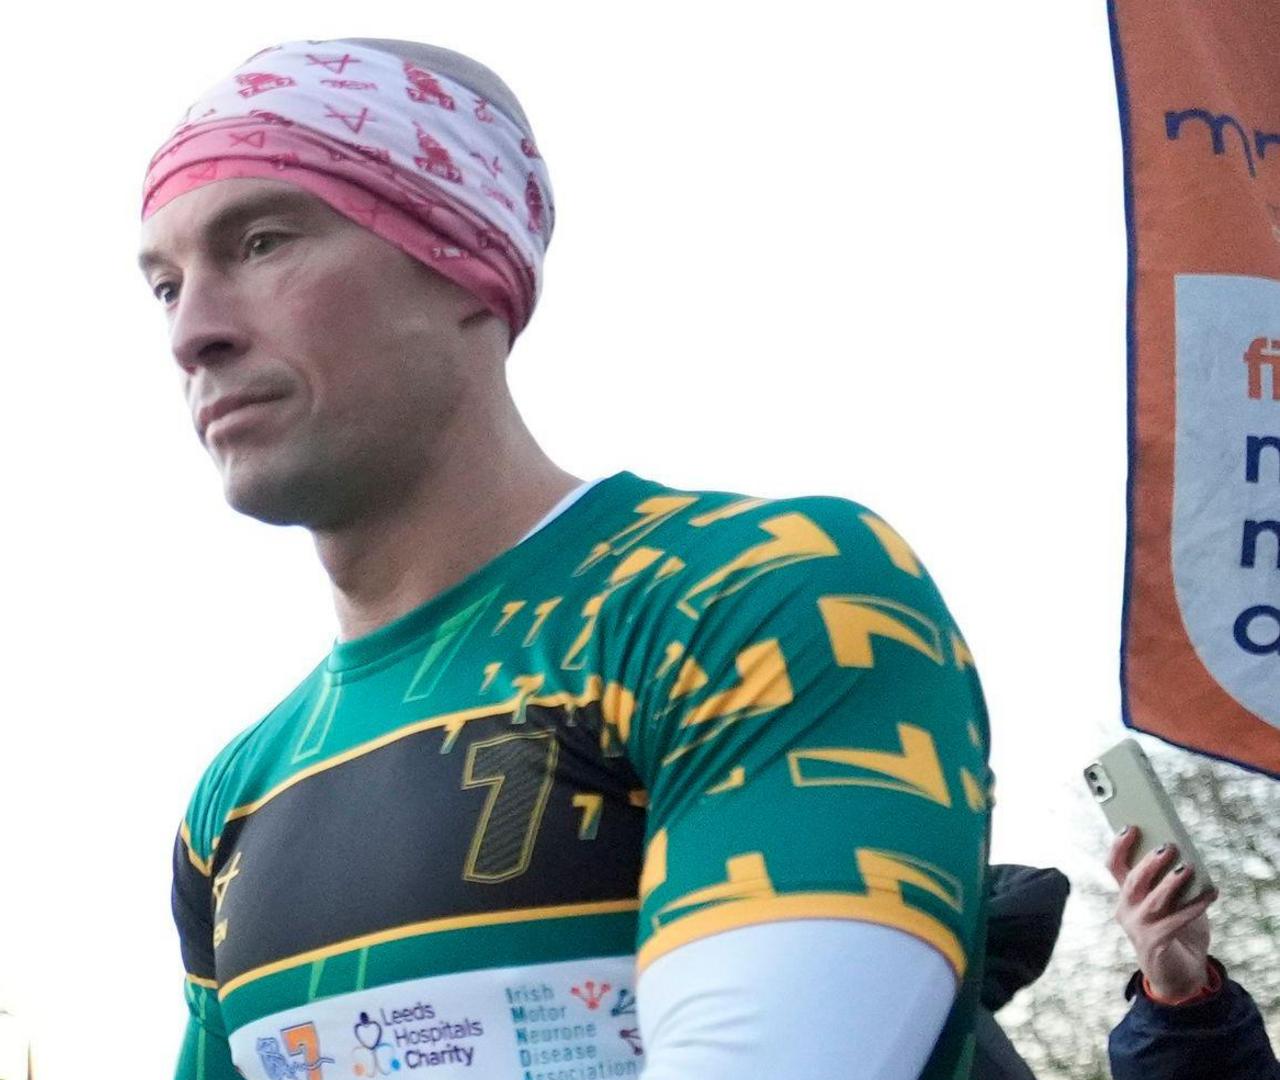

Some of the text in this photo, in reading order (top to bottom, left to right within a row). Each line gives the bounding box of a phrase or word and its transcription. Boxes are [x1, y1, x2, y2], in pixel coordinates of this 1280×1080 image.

[505, 984, 554, 1004] Irish
[380, 1002, 436, 1026] Leeds
[511, 1004, 567, 1023] Motor
[394, 1018, 484, 1047] Hospitals
[404, 1046, 474, 1069] Charity
[519, 1045, 596, 1068] Disease
